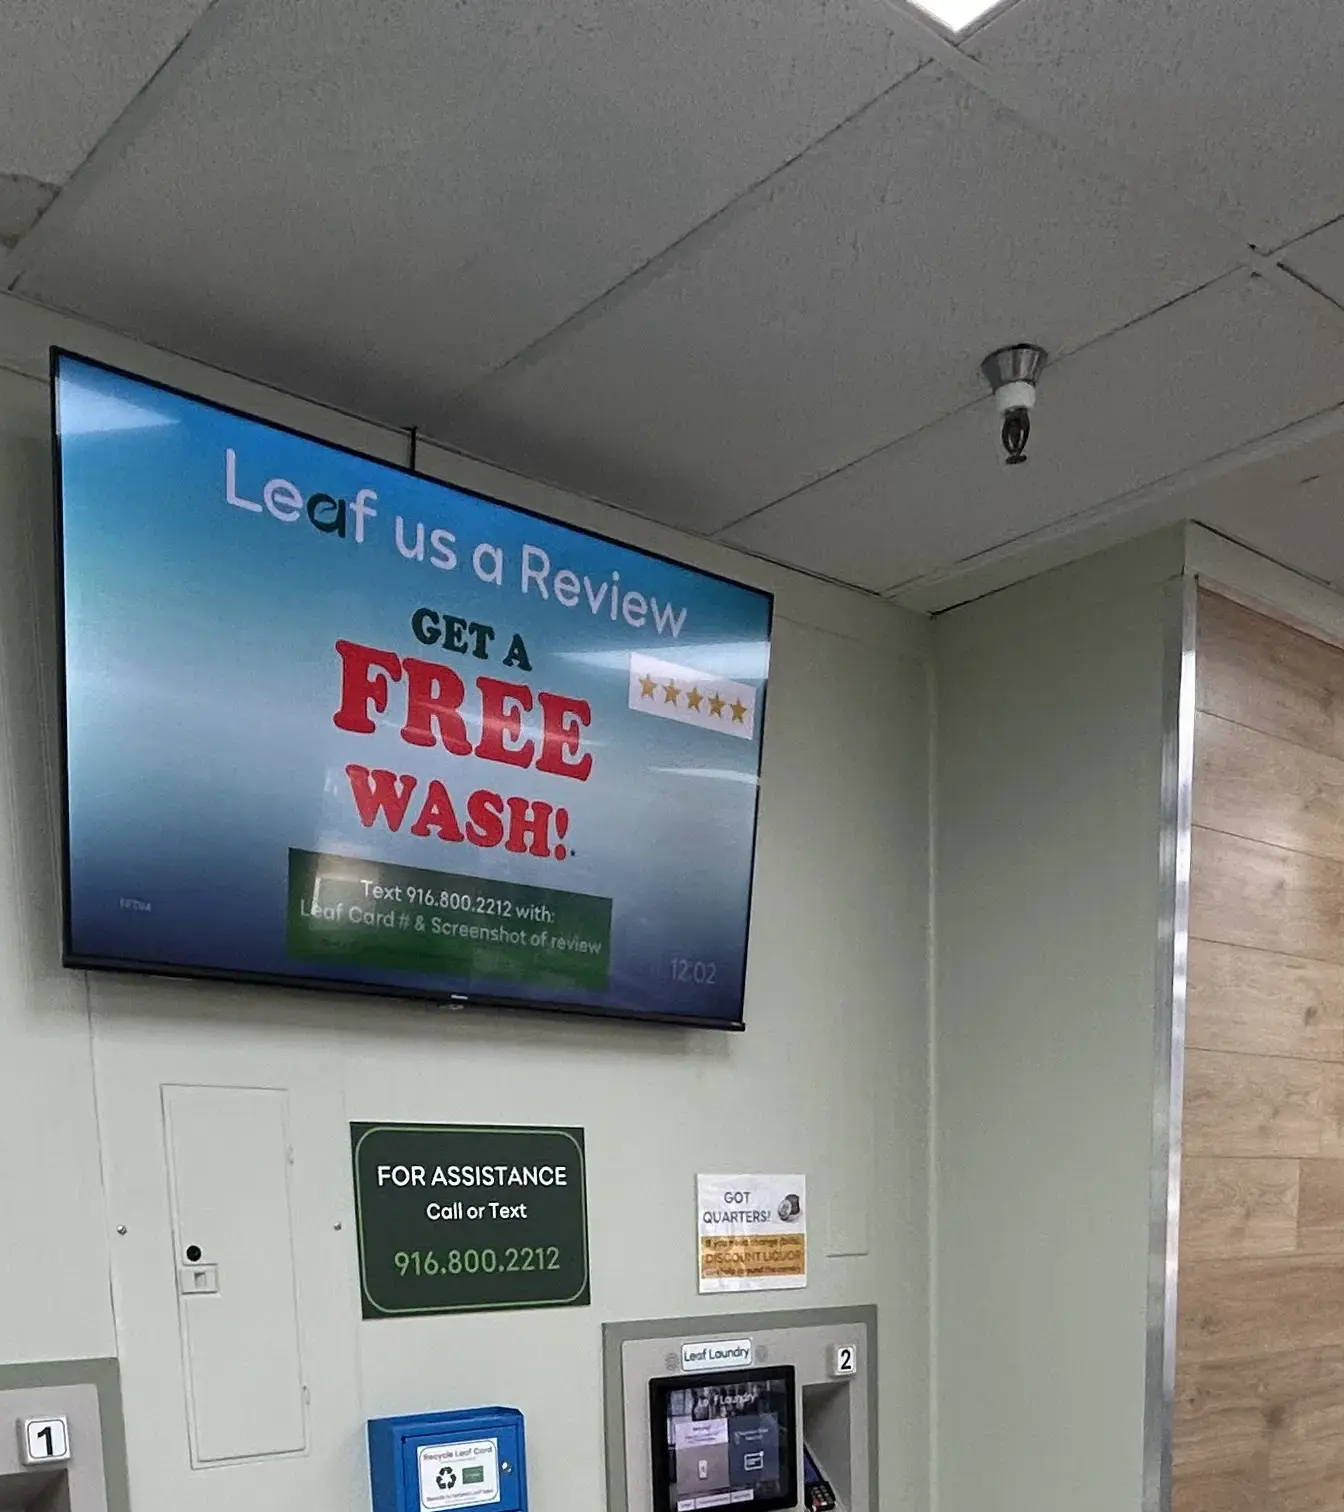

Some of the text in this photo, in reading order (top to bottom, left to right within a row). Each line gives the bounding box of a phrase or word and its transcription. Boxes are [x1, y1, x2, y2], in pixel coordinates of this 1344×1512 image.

[225, 447, 688, 639] Leaf us a Review
[411, 607, 533, 671] GET A
[332, 639, 594, 782] FREE
[360, 879, 556, 925] Text 916.800.2212 with:
[300, 898, 602, 956] Leaf Card # & Screenshot of review
[669, 958, 718, 986] 12:02
[376, 1165, 568, 1187] FOR ASSISTANCE
[426, 1202, 528, 1221] Call or Text
[723, 1191, 751, 1204] GOT
[393, 1246, 561, 1277] 916.800.2212
[683, 1346, 750, 1362] Leaf Laundry
[840, 1349, 852, 1370] 2
[35, 1425, 54, 1457] 1
